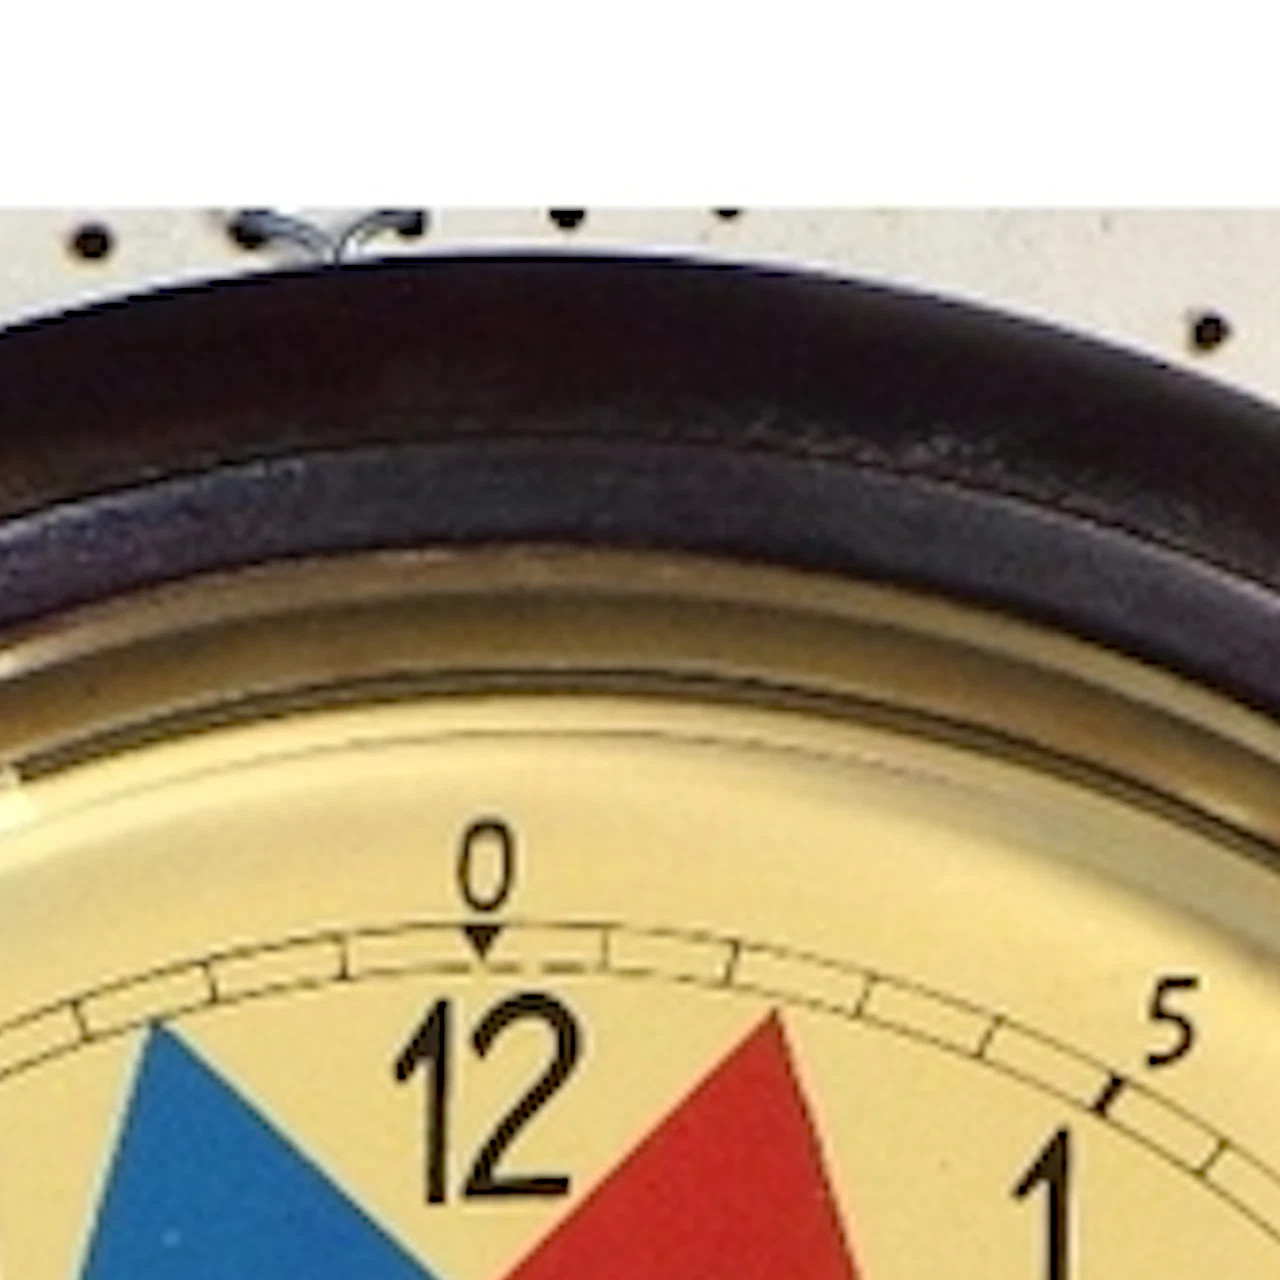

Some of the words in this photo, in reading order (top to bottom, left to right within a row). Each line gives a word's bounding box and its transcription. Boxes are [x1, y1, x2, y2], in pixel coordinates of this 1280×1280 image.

[456, 818, 514, 914] 0
[1146, 976, 1199, 1069] 5
[393, 991, 581, 1206] 12
